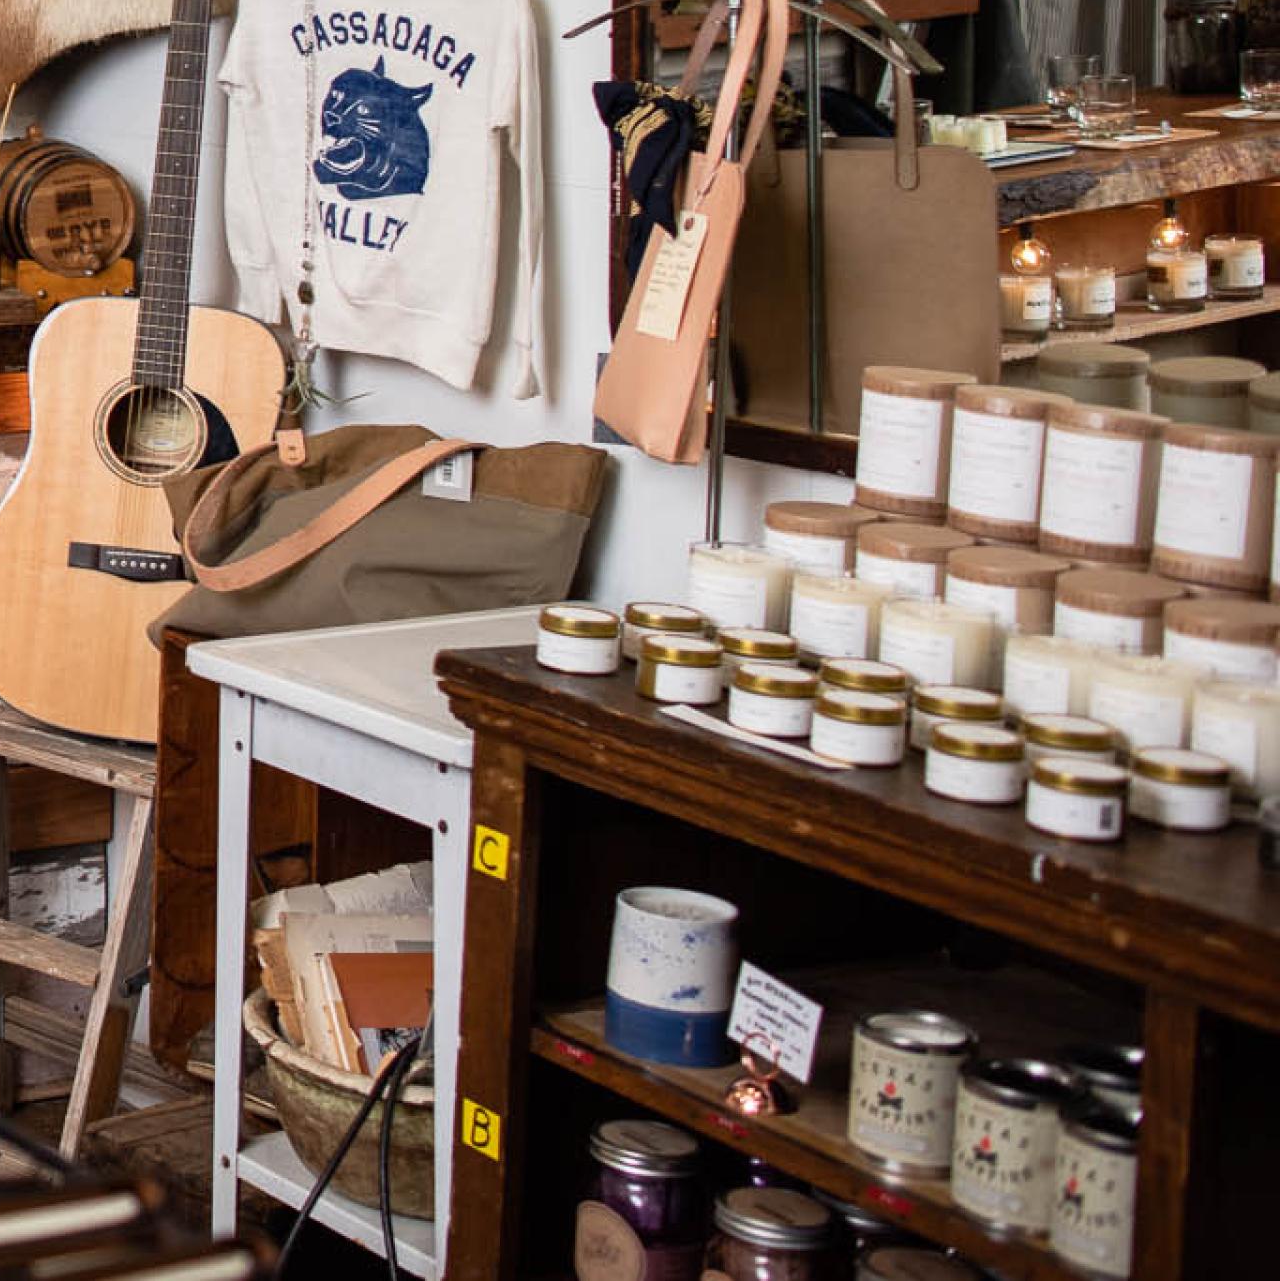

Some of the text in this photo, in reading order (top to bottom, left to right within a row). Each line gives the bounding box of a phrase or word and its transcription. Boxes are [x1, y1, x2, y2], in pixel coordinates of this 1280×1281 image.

[290, 10, 477, 89] CASSADAGA
[479, 835, 499, 871] C
[471, 1107, 491, 1148] B
[1056, 1152, 1116, 1194] EXAS
